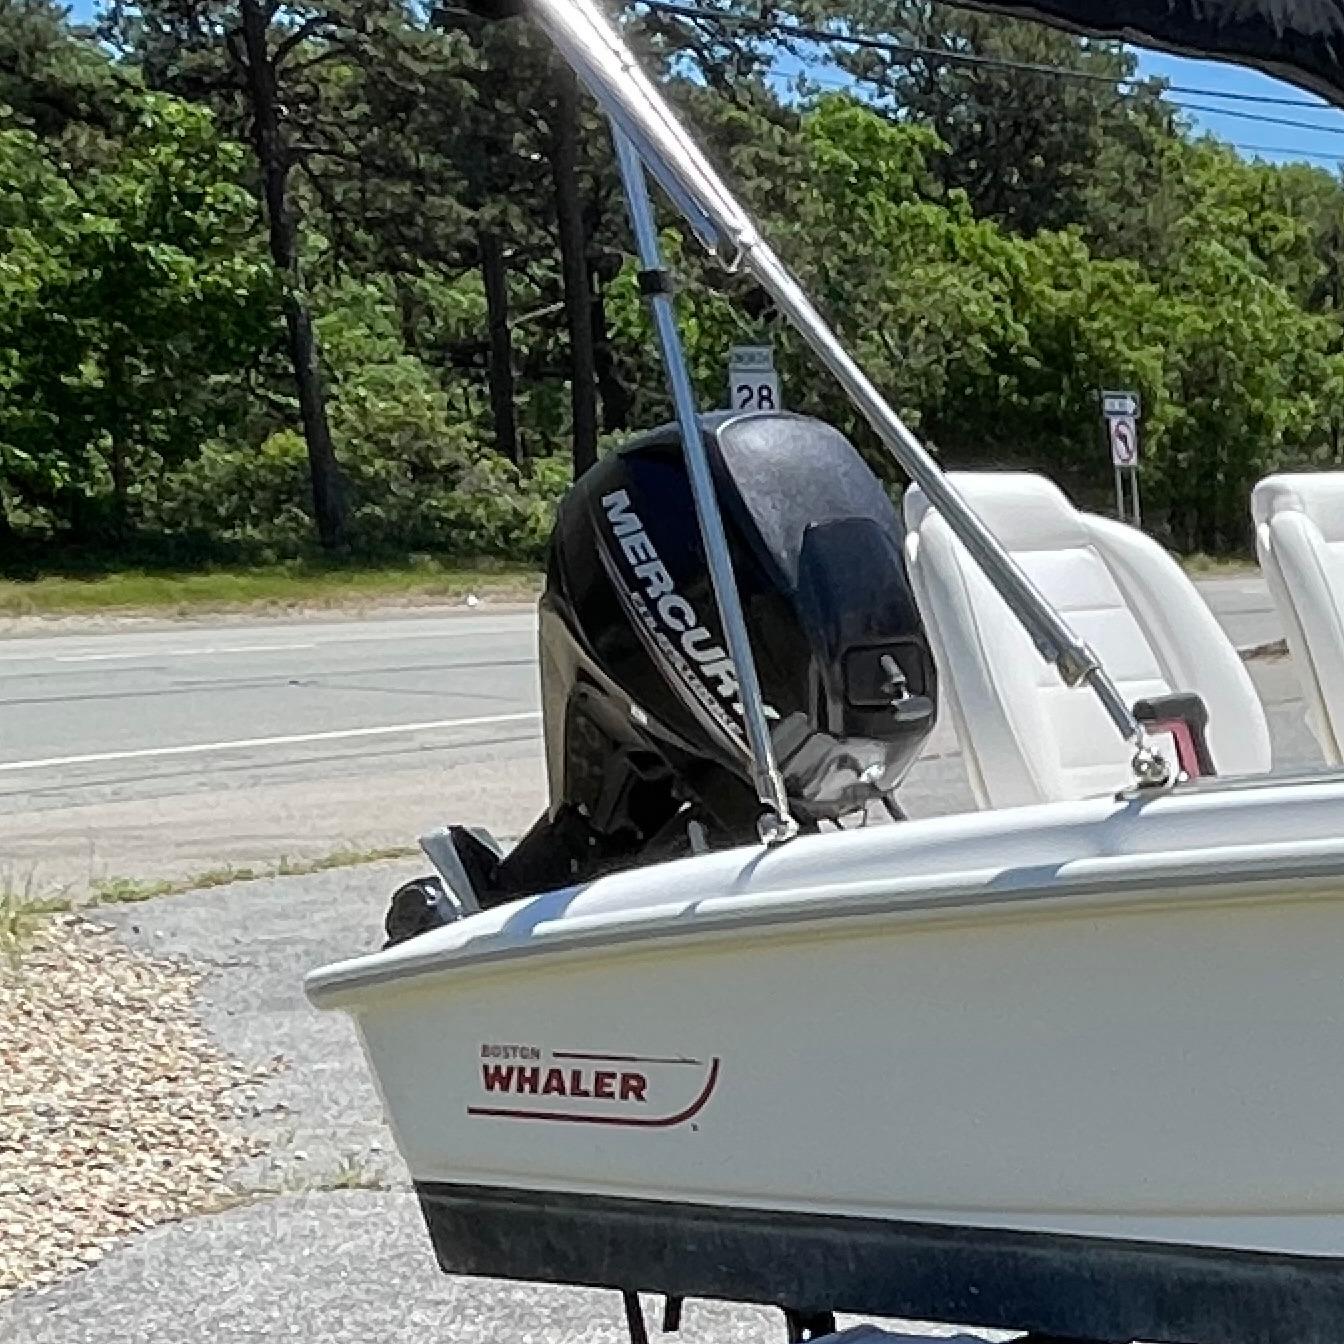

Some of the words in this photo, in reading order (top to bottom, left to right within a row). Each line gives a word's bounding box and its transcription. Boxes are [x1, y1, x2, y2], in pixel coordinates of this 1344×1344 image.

[736, 384, 776, 410] 28
[480, 1044, 540, 1060] BOSTON
[482, 1064, 647, 1103] WHALER
